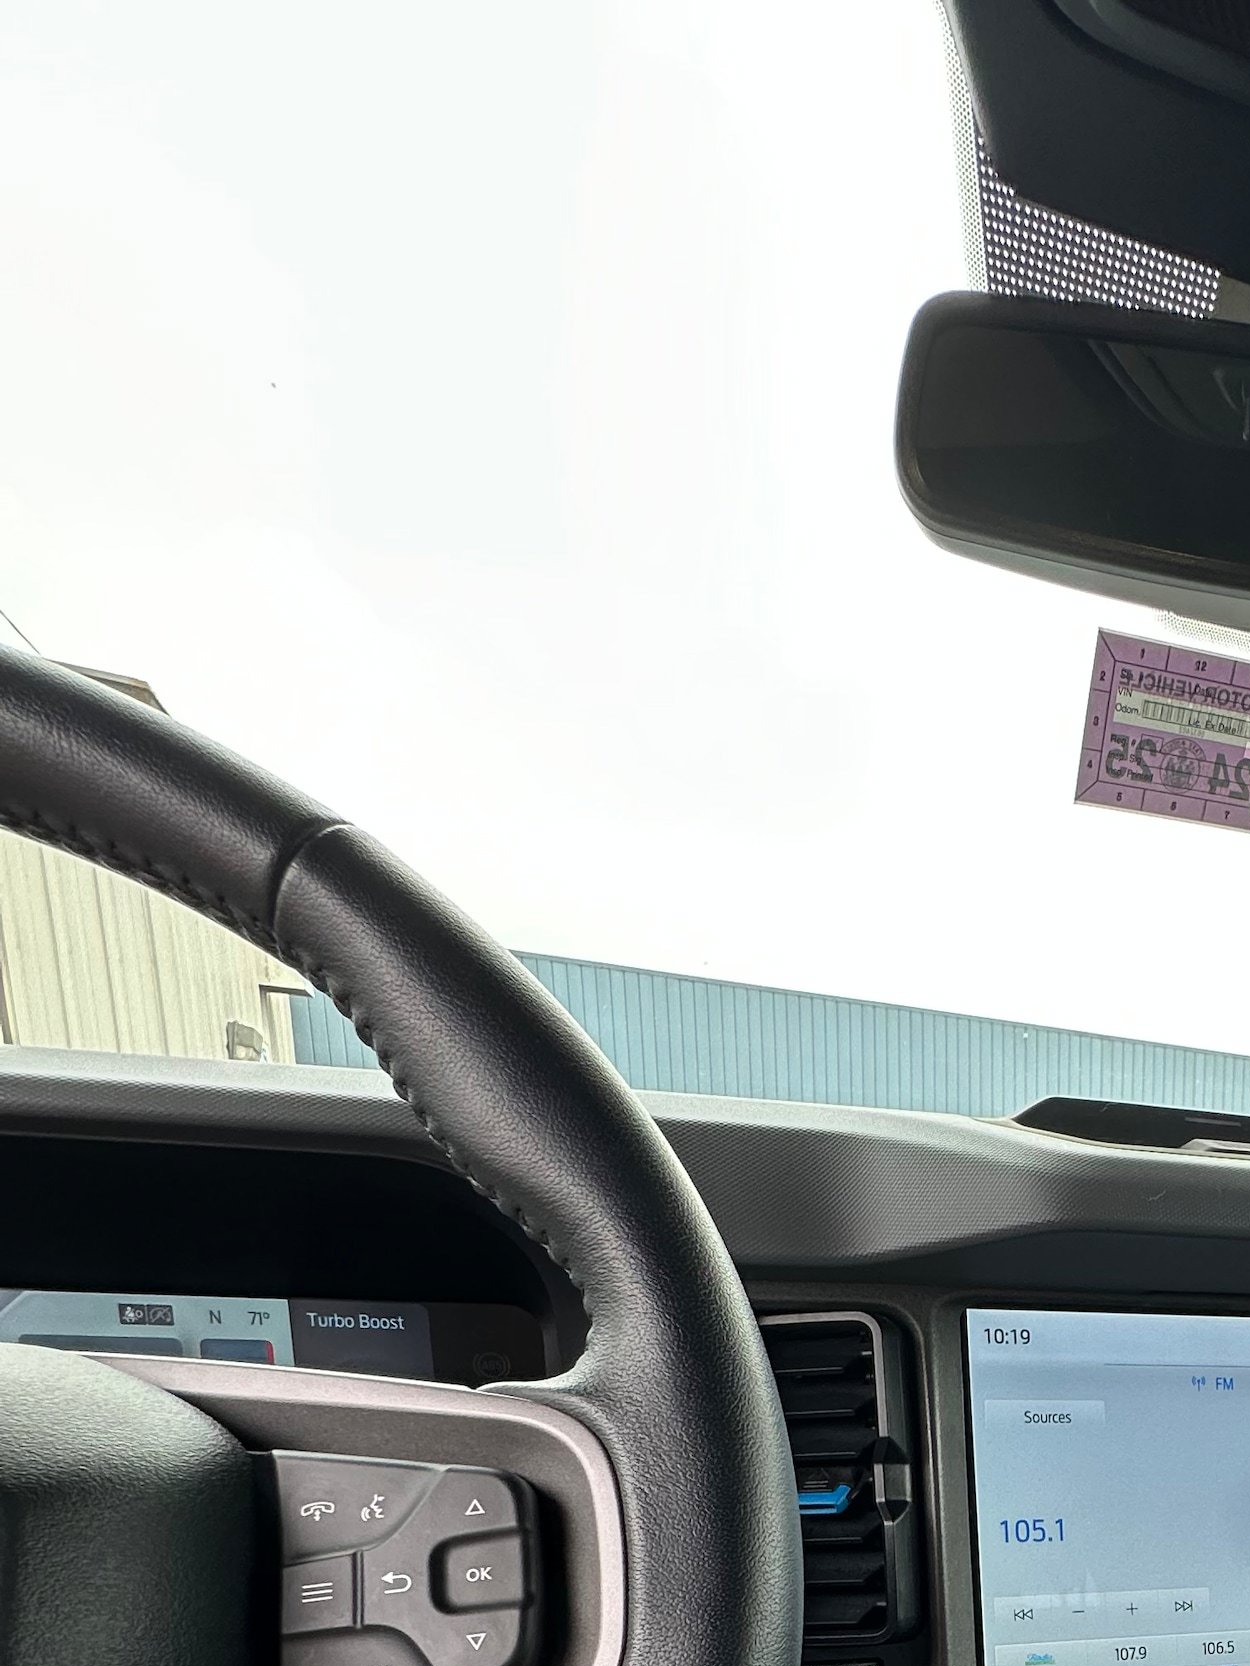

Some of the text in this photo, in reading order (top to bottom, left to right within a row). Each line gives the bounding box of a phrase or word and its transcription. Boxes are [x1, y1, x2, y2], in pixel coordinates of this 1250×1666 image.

[1117, 687, 1133, 698] VIN
[208, 1309, 222, 1325] N
[306, 1312, 405, 1331] Turbo Boost
[983, 1328, 1031, 1345] 10:19
[1215, 1376, 1235, 1391] FM
[1023, 1410, 1072, 1424] Sources
[1000, 1518, 1065, 1543] 105.1
[465, 1566, 493, 1583] OK
[1115, 1646, 1147, 1661] 107.9
[1202, 1640, 1235, 1656] 106.5
